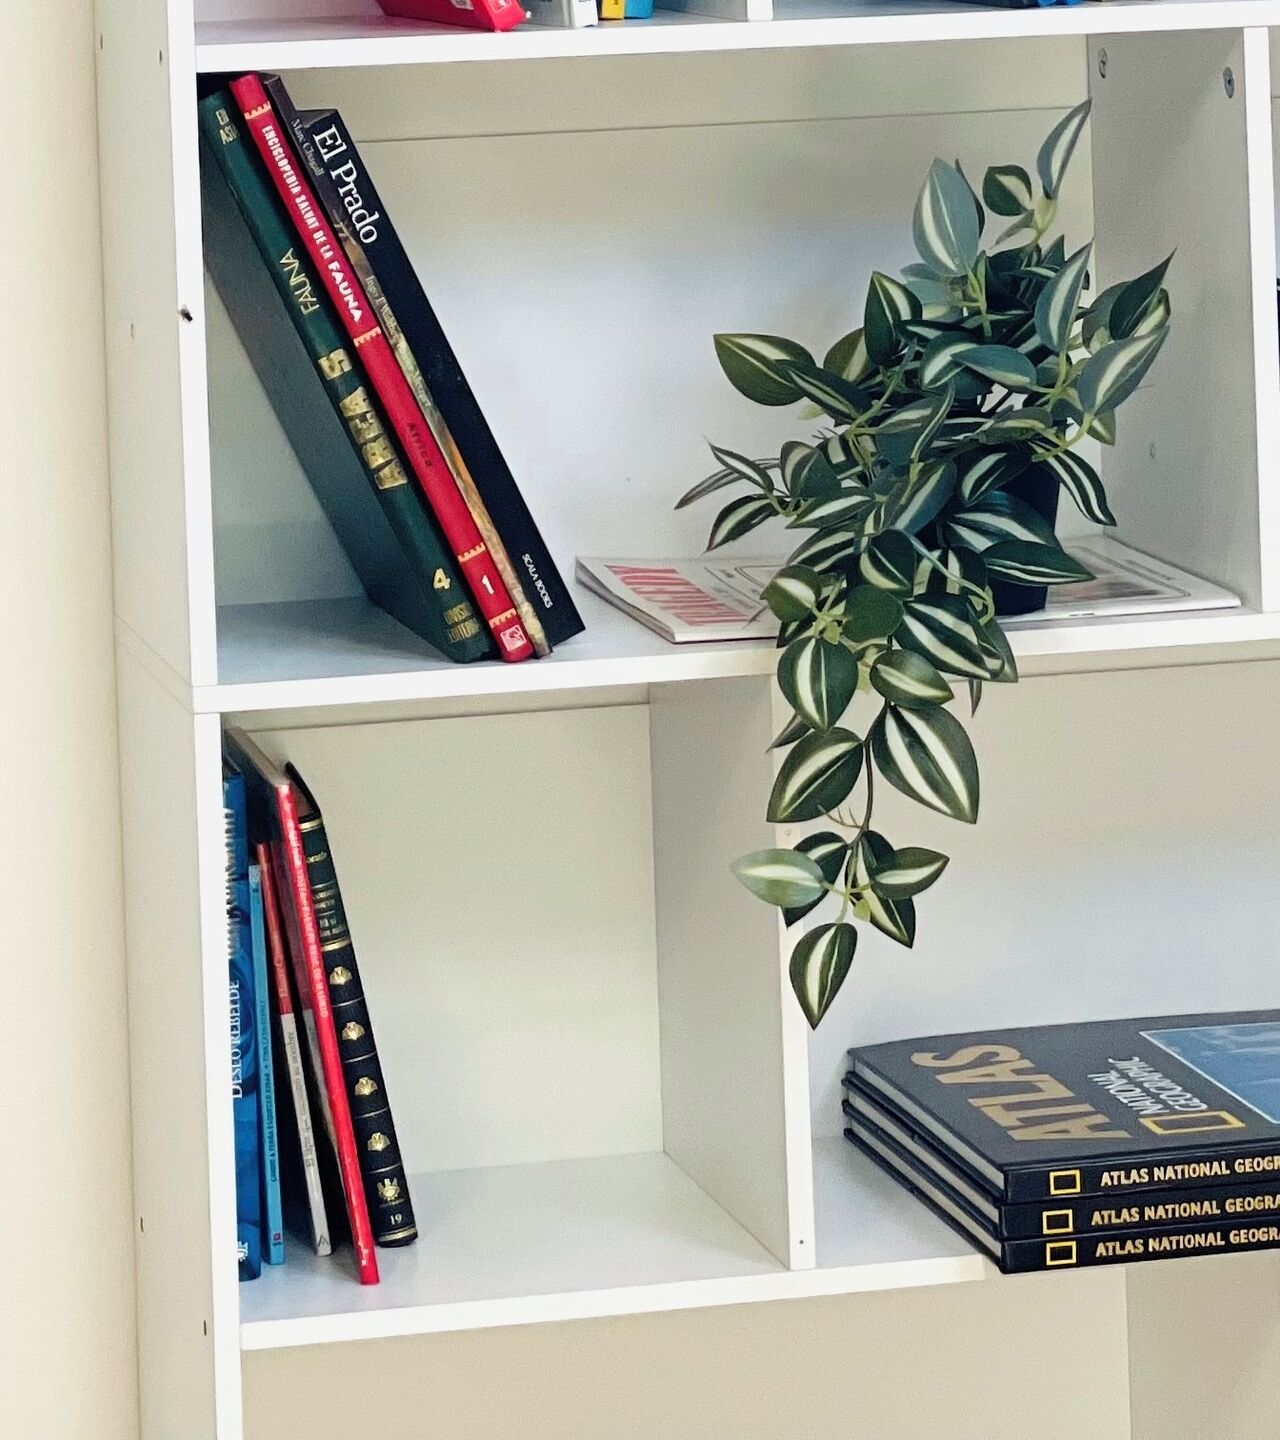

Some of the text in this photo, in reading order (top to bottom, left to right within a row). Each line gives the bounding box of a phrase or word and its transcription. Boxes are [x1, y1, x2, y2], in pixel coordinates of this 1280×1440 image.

[291, 118, 325, 177] Marc Chagall
[312, 124, 380, 244] El Prado
[261, 125, 363, 323] ENCICLOPEDIA SALVAT DE LA FAUNA
[280, 248, 320, 316] FAUNA
[433, 568, 451, 590] 4
[481, 575, 495, 595] 1
[522, 553, 554, 609] SCALA BOOKS
[910, 1044, 1133, 1142] ATLAS
[1087, 1072, 1170, 1115] NATIONAL
[1107, 1056, 1208, 1111] GEOGRAPHIC
[1100, 1167, 1150, 1188] ATLAS
[1152, 1159, 1231, 1182] NATIONAL
[390, 1213, 403, 1225] 19
[1090, 1207, 1140, 1227] ATLAS
[1143, 1198, 1222, 1222] NATIONAL
[1094, 1238, 1145, 1259] ATLAS
[1147, 1230, 1226, 1253] NATIONAL
